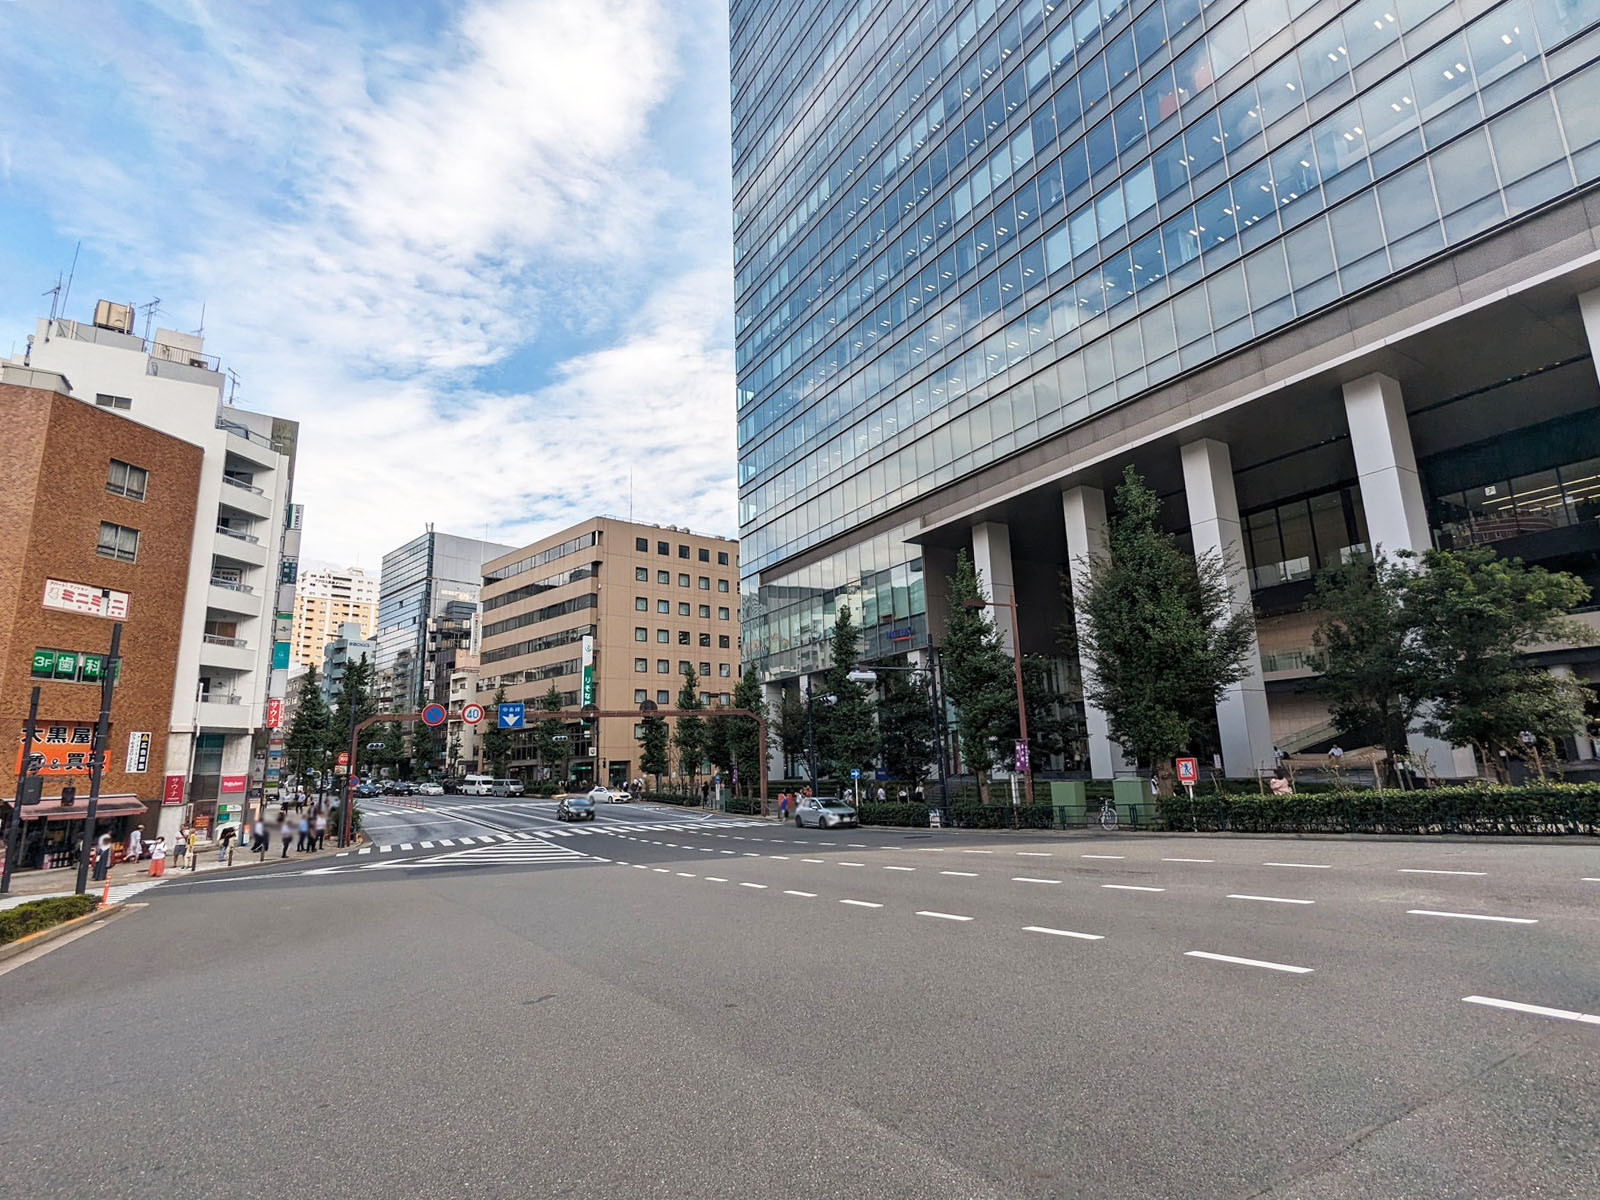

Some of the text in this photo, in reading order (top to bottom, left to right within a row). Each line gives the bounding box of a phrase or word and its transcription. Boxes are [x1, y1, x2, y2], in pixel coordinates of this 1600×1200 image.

[33, 656, 53, 667] 3F
[269, 701, 279, 726] サウナ
[466, 709, 479, 718] 40
[170, 777, 179, 797] サウナ
